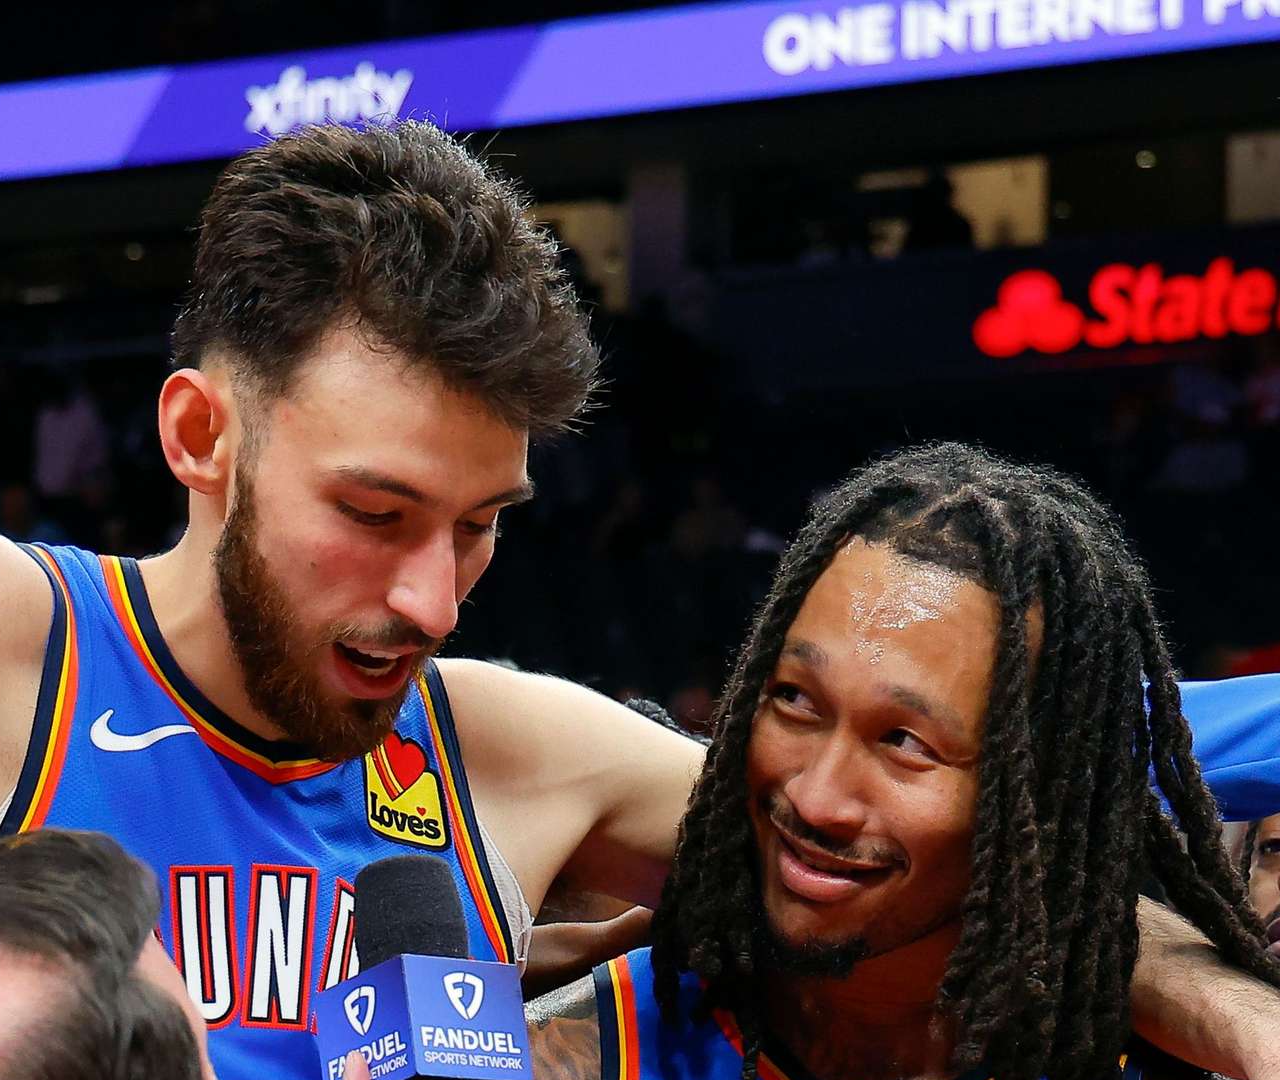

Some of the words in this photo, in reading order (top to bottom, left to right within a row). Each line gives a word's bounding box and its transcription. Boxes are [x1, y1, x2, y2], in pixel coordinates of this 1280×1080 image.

[763, 2, 893, 76] ONE
[420, 1026, 521, 1055] FANDUEL
[370, 1053, 408, 1080] ETWORK
[424, 1051, 469, 1067] SPORTS
[469, 1055, 523, 1070] NETWORK
